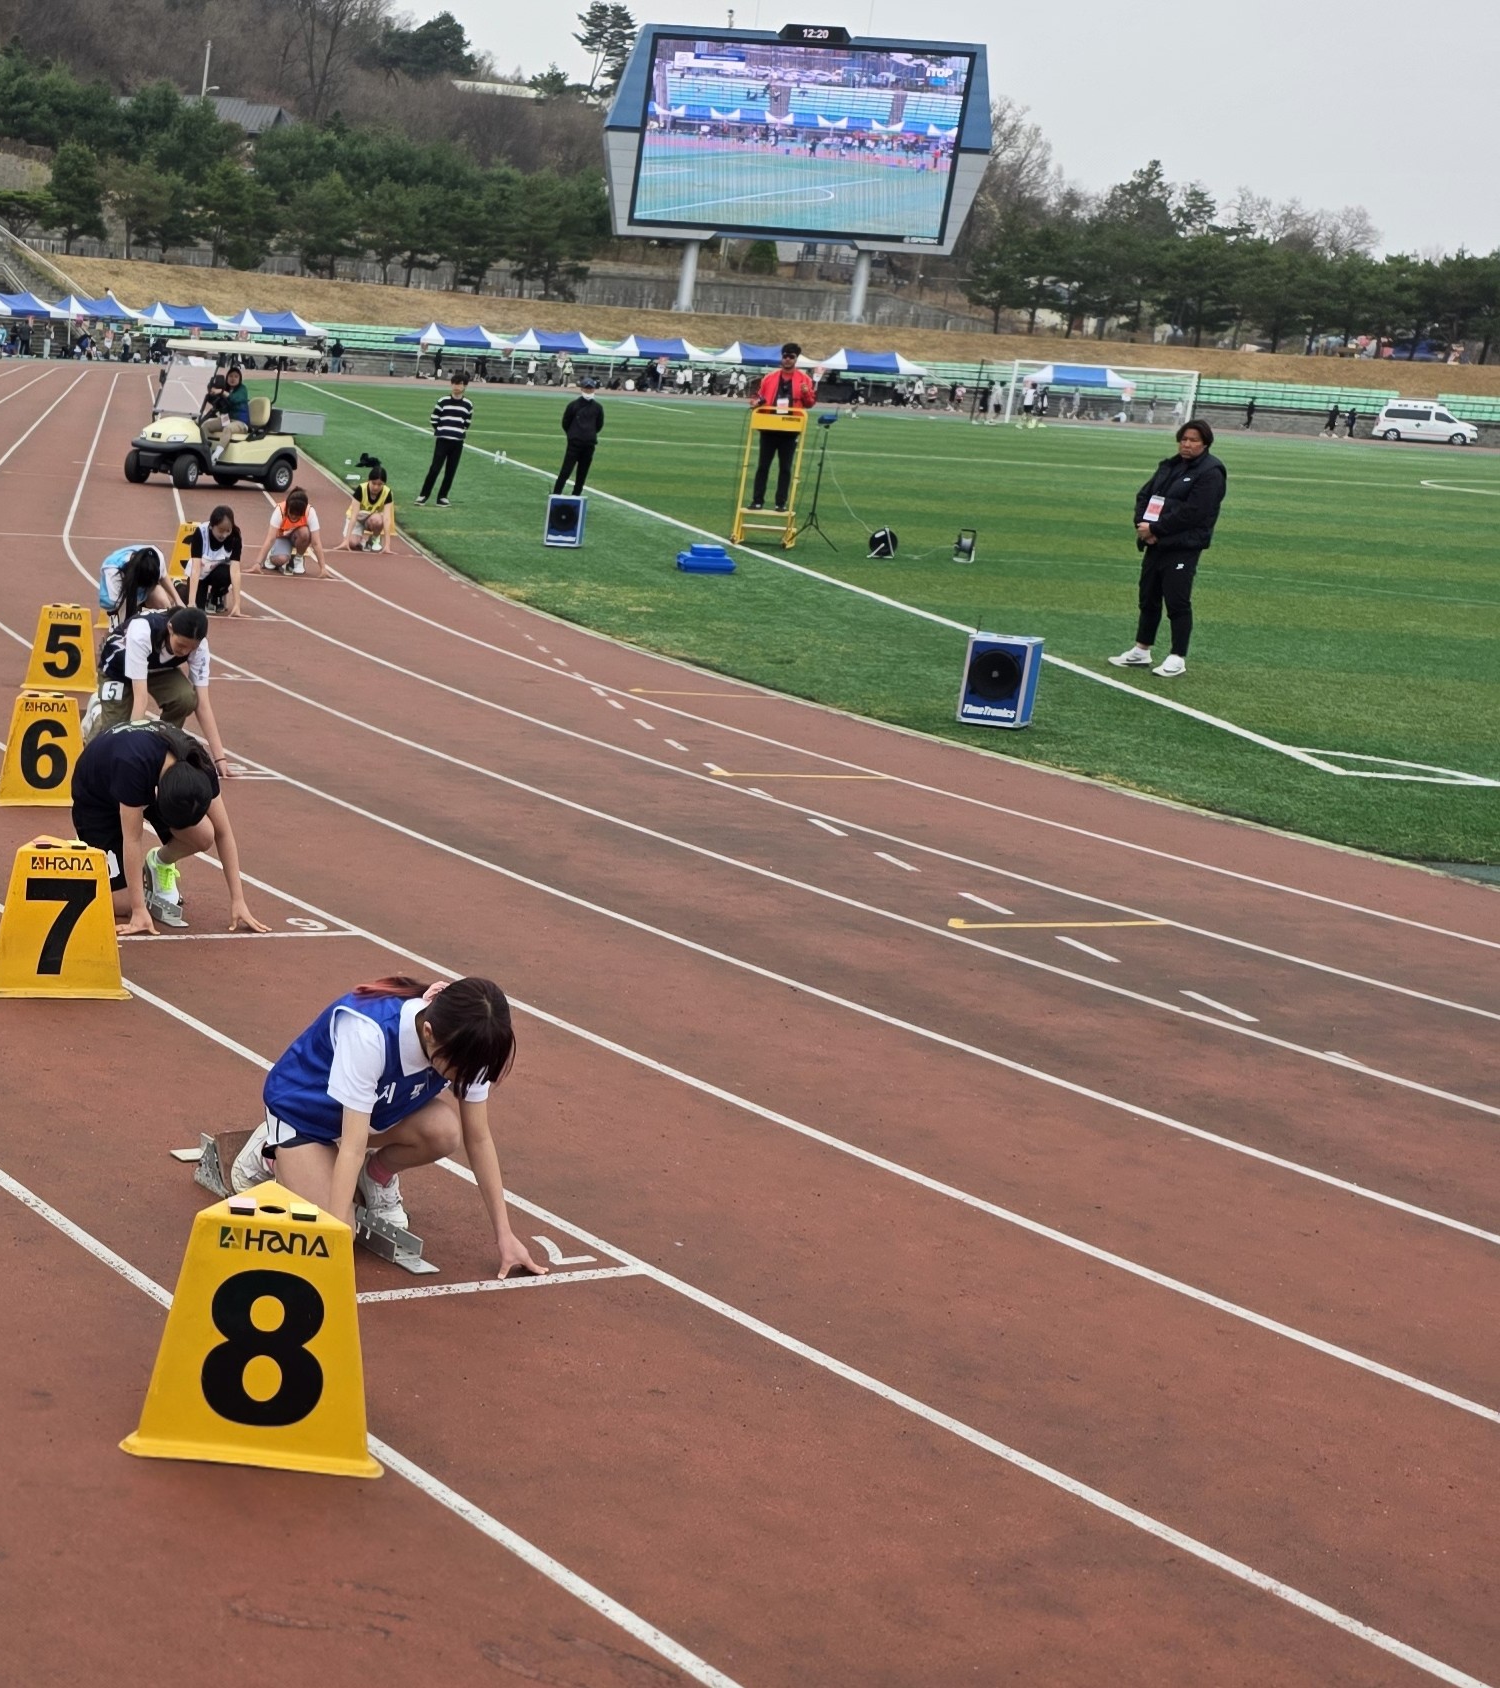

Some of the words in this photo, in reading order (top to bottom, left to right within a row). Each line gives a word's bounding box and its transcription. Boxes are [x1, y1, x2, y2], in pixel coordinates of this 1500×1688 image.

[802, 28, 829, 39] 12:20
[43, 623, 82, 679] 5
[107, 682, 119, 700] 5
[963, 703, 1016, 719] TimeTronics
[20, 719, 68, 790] 6
[25, 877, 98, 975] 7
[201, 1269, 325, 1427] 8
